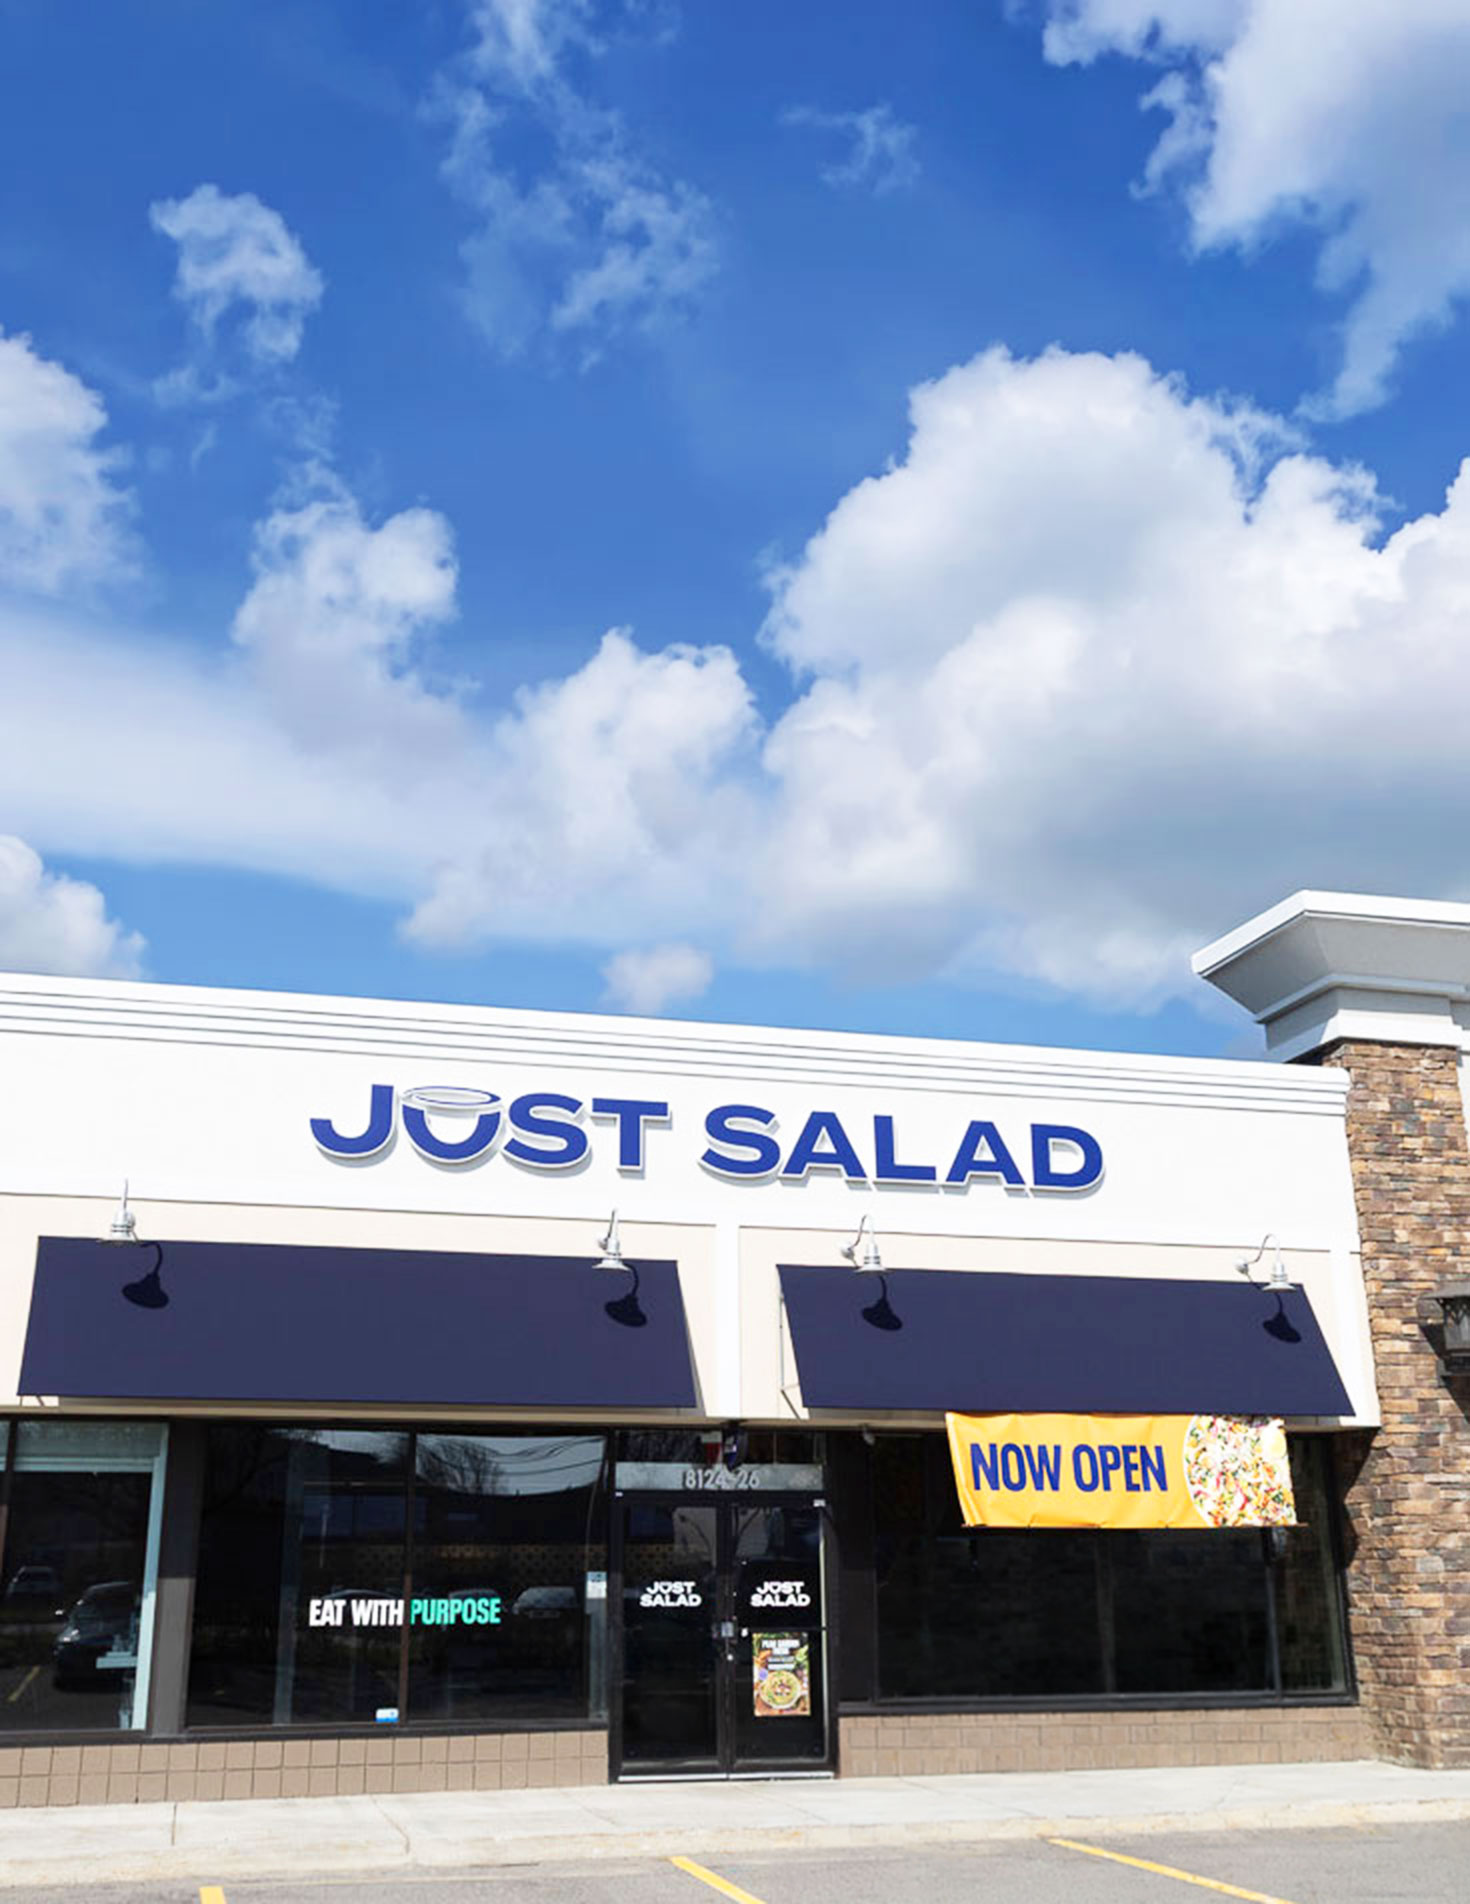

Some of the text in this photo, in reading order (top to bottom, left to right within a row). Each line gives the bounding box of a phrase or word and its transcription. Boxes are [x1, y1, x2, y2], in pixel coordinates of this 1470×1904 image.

[309, 1083, 1103, 1189] JUST SALAD
[969, 1442, 1168, 1493] NOW OPEN
[646, 1581, 696, 1595] JUST
[756, 1581, 805, 1595] JUST
[640, 1594, 702, 1607] SALAD
[750, 1594, 811, 1607] SALAD
[309, 1598, 501, 1627] EAT WITH PURPOSE
